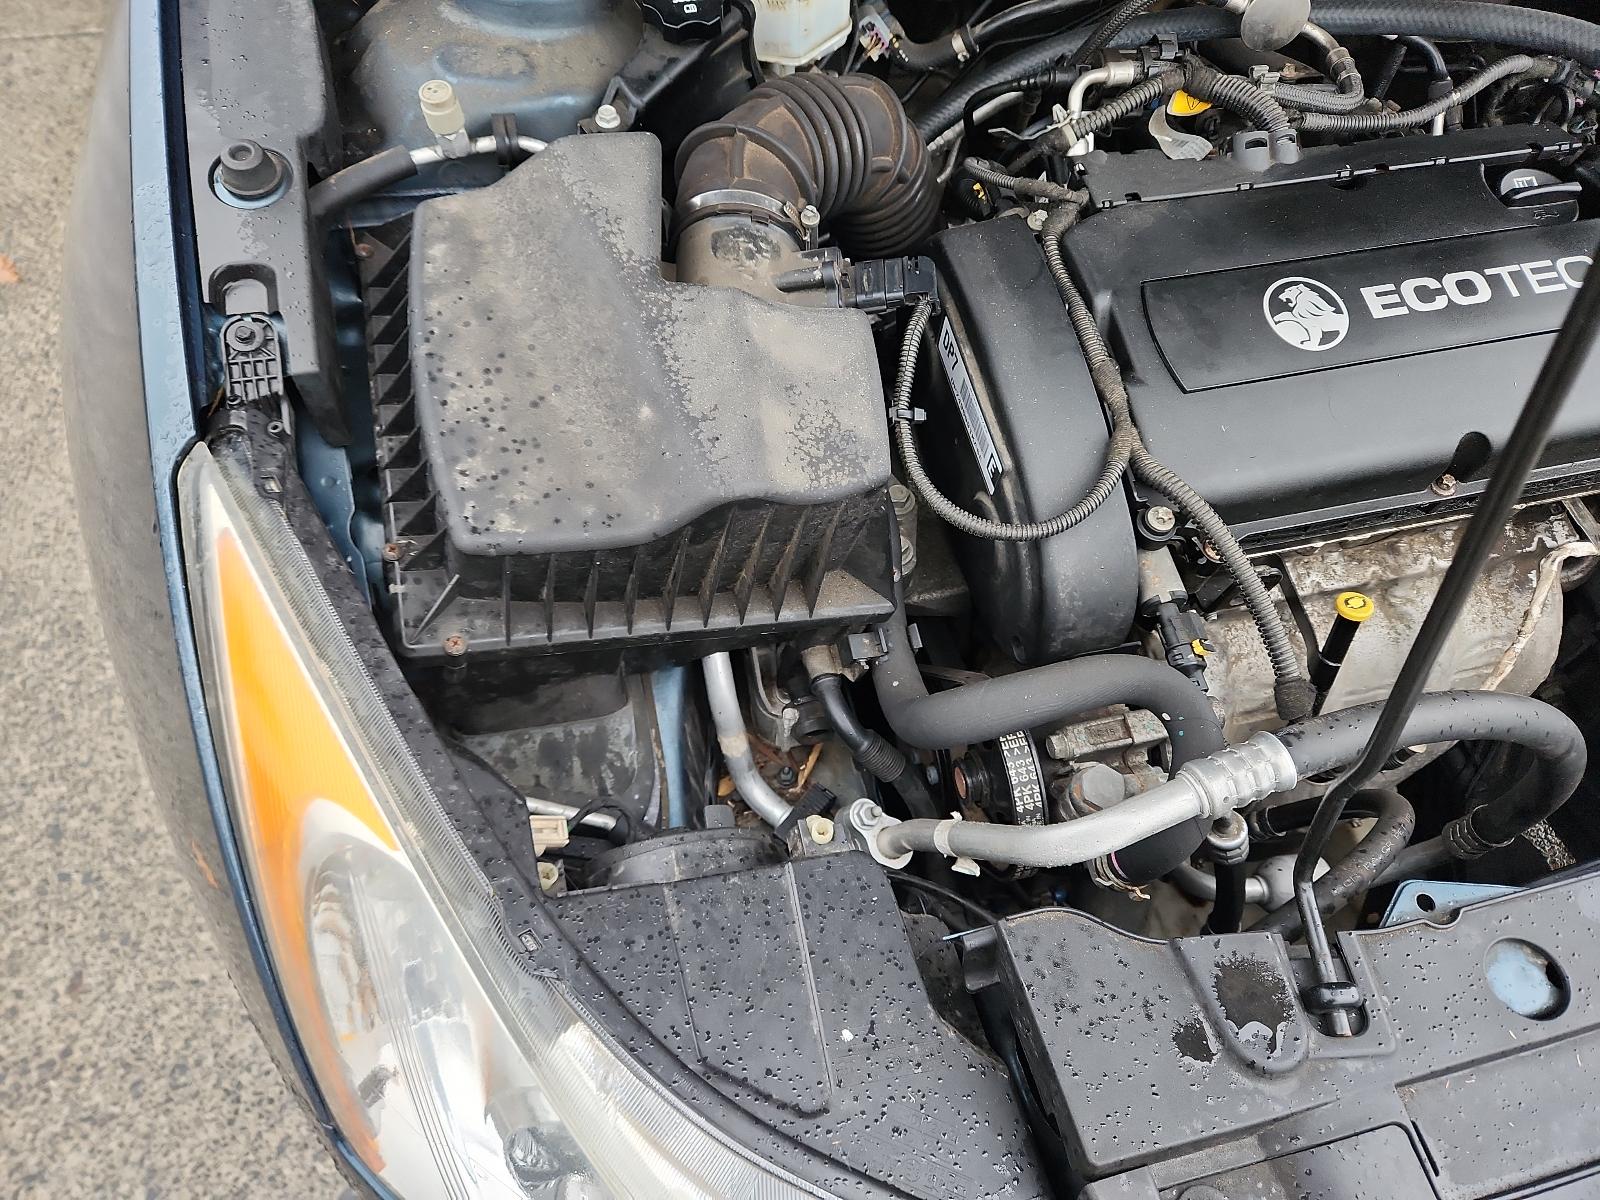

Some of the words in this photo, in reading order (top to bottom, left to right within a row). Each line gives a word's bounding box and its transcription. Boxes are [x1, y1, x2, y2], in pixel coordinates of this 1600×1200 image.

[1360, 255, 1594, 319] ECOTEC
[1016, 759, 1029, 782] 643
[1021, 784, 1036, 811] 4PK
